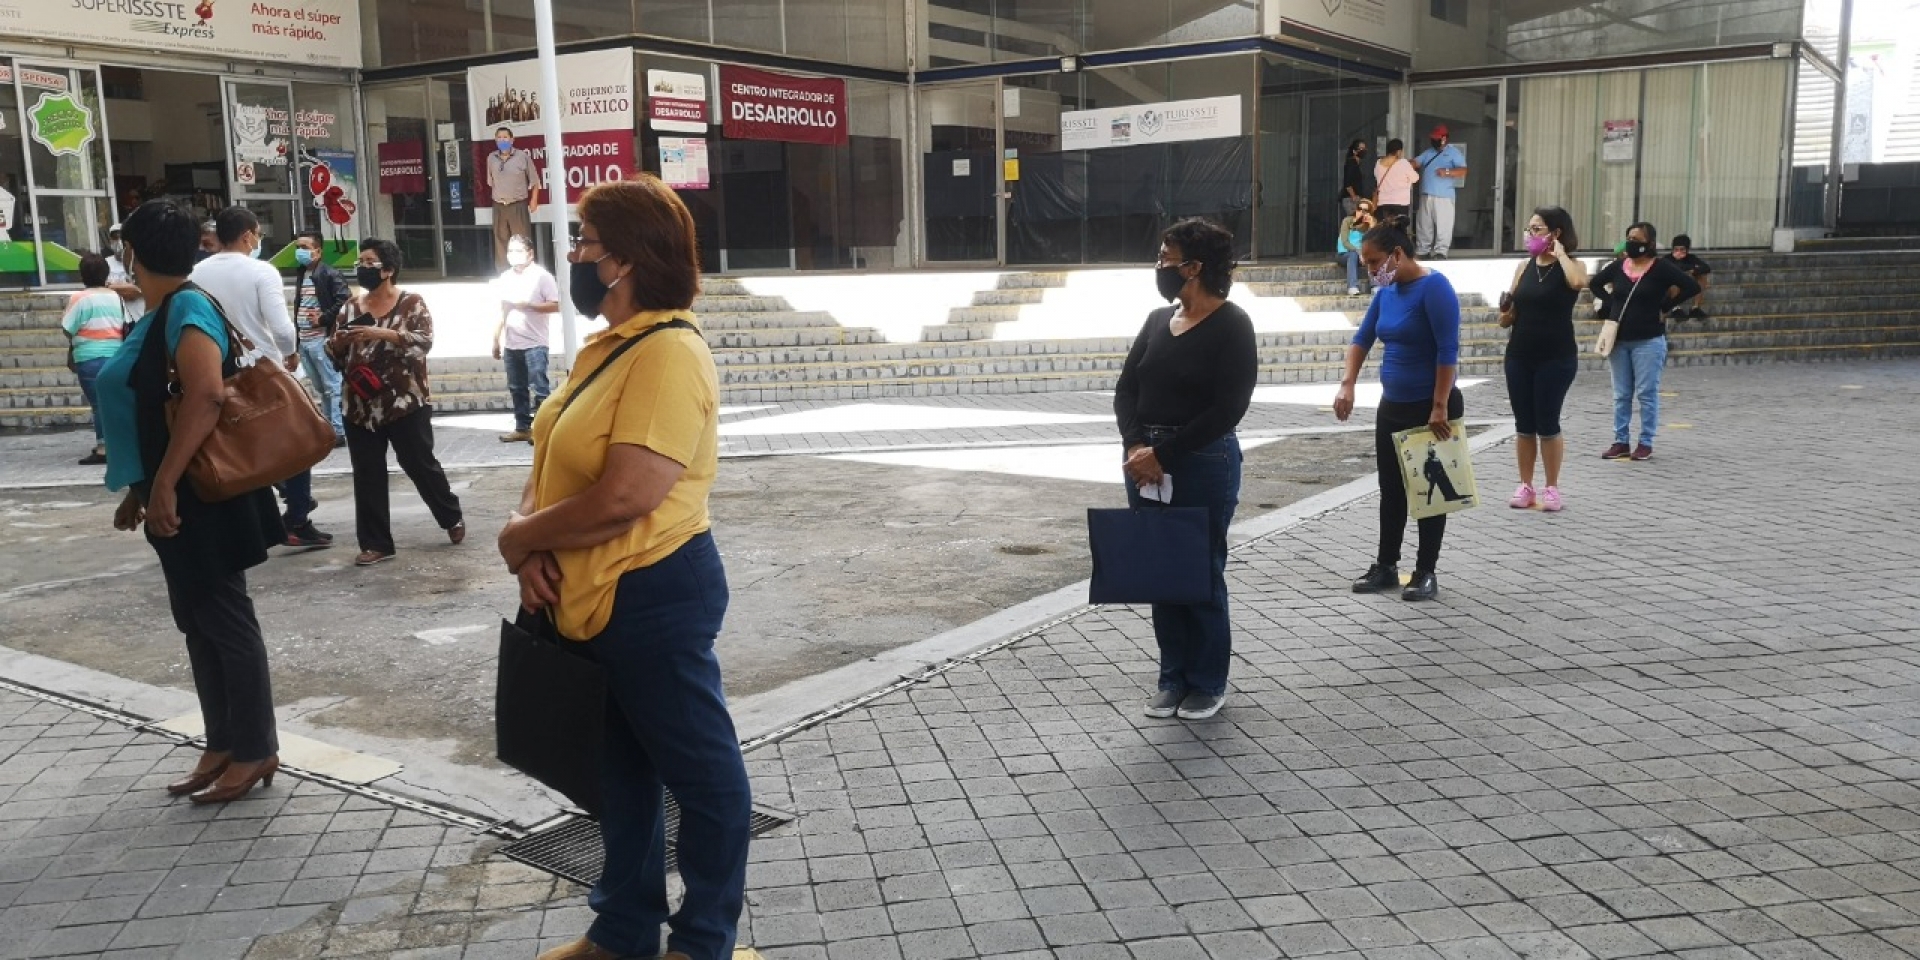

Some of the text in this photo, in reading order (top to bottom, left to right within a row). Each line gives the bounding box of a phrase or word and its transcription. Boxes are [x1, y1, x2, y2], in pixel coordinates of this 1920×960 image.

[72, 0, 187, 20] SUPERISSSTE
[251, 2, 341, 25] Ahora el súper
[164, 22, 215, 39] Express
[251, 21, 327, 41] más rápido.
[569, 84, 628, 98] GOBIERNO DE
[731, 83, 835, 104] CENTRO INTEGRADOR DE
[570, 97, 629, 115] MÉXICO
[655, 107, 701, 119] DESARROLLO
[731, 101, 837, 128] DESARROLLO
[1164, 106, 1219, 120] TURISSSTE
[532, 142, 601, 160] INTRADOR
[602, 142, 619, 156] DE
